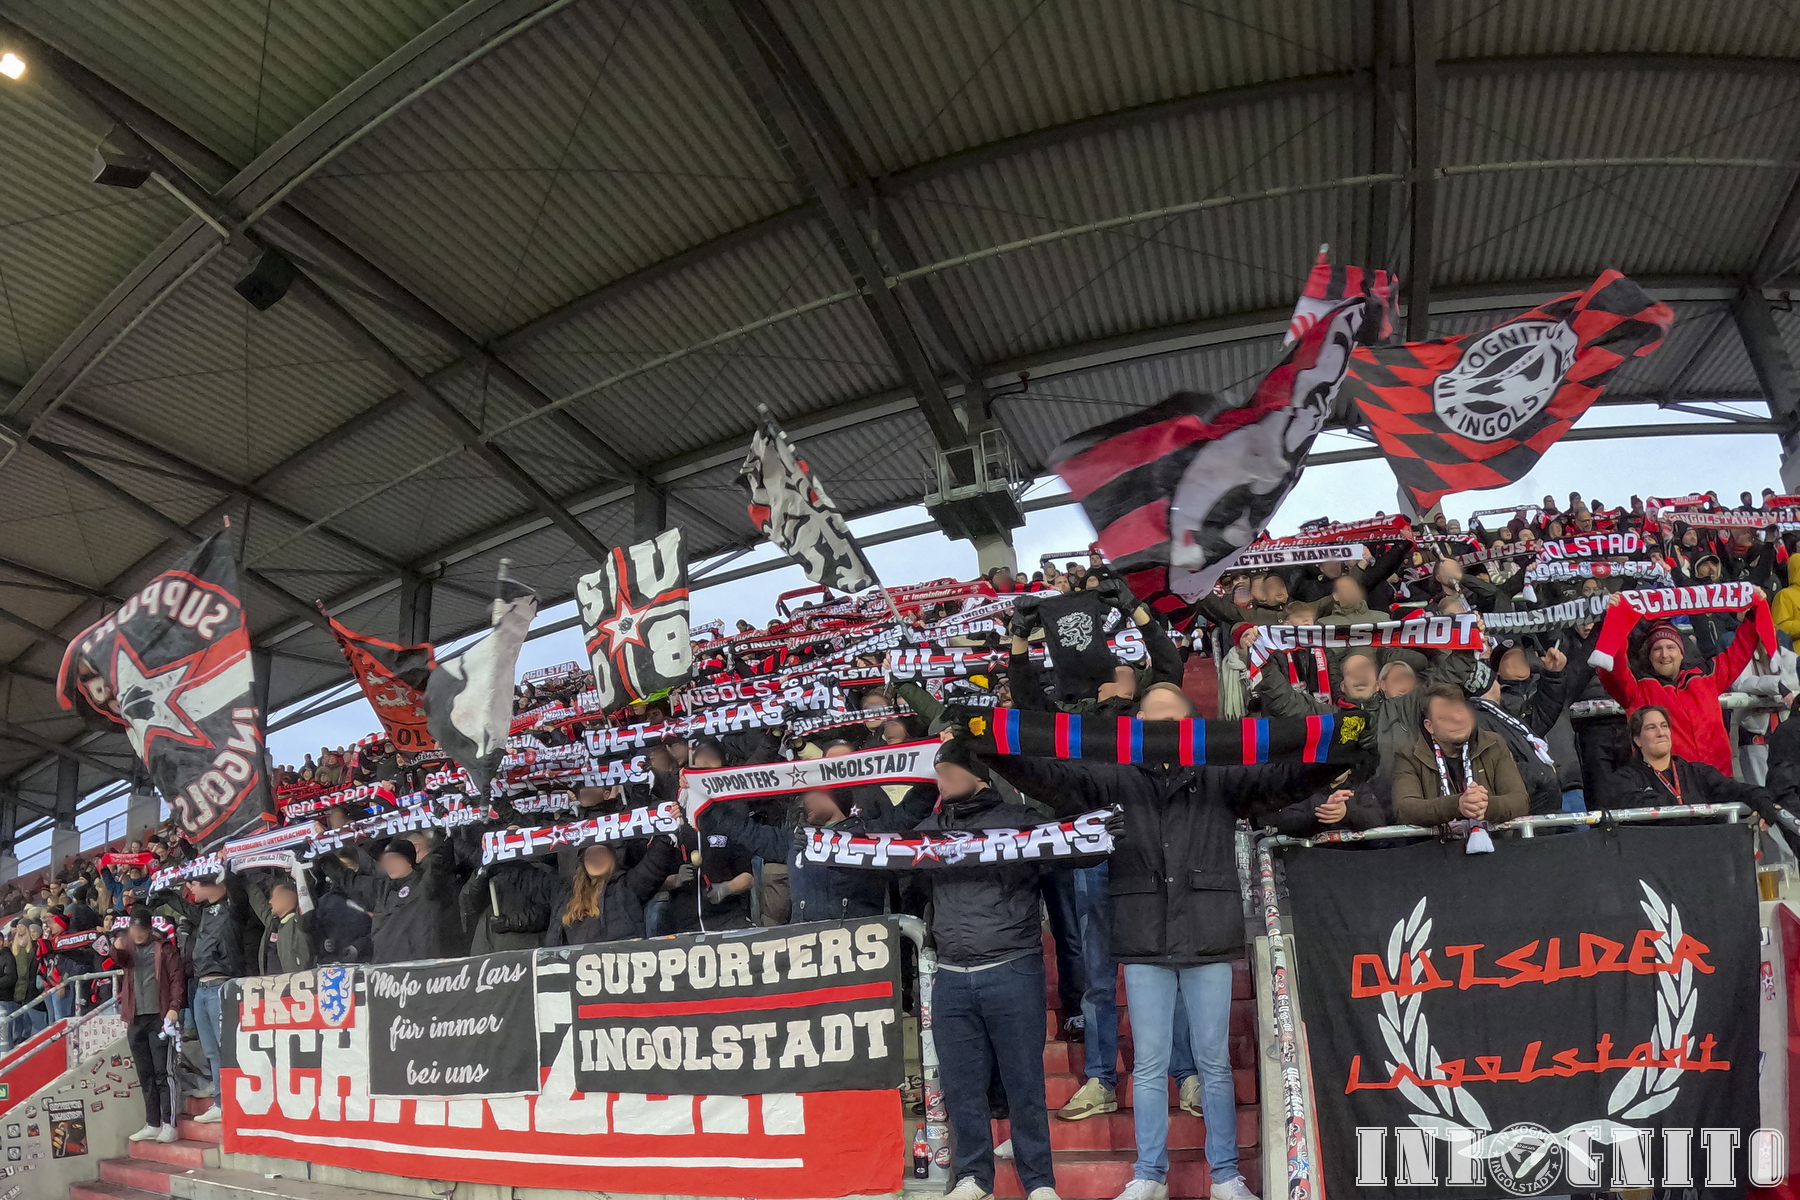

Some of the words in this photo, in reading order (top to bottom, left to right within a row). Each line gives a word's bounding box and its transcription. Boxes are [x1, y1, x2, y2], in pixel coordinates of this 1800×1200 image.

[1292, 547, 1353, 562] MANEO
[1483, 598, 1585, 628] INGOLSTADT
[1622, 582, 1753, 616] SCHANZER
[585, 723, 651, 756] ULT
[703, 696, 785, 736] RAS
[701, 769, 780, 796] SUPPORTERS
[818, 751, 920, 782] INGOLSTADT
[594, 801, 678, 843] RAS
[803, 826, 902, 867] ULT
[979, 809, 1115, 863] RAS
[426, 964, 470, 995] und
[475, 958, 527, 993] Lars
[575, 923, 890, 997] SUPPORTERS
[1351, 929, 1716, 998] OUTSIDER
[241, 978, 315, 1029] FKS
[390, 1014, 425, 1051] für
[429, 1013, 503, 1039] immer
[578, 1008, 896, 1072] INGOLSTADT
[406, 1059, 440, 1086] bei
[445, 1062, 489, 1084] uns
